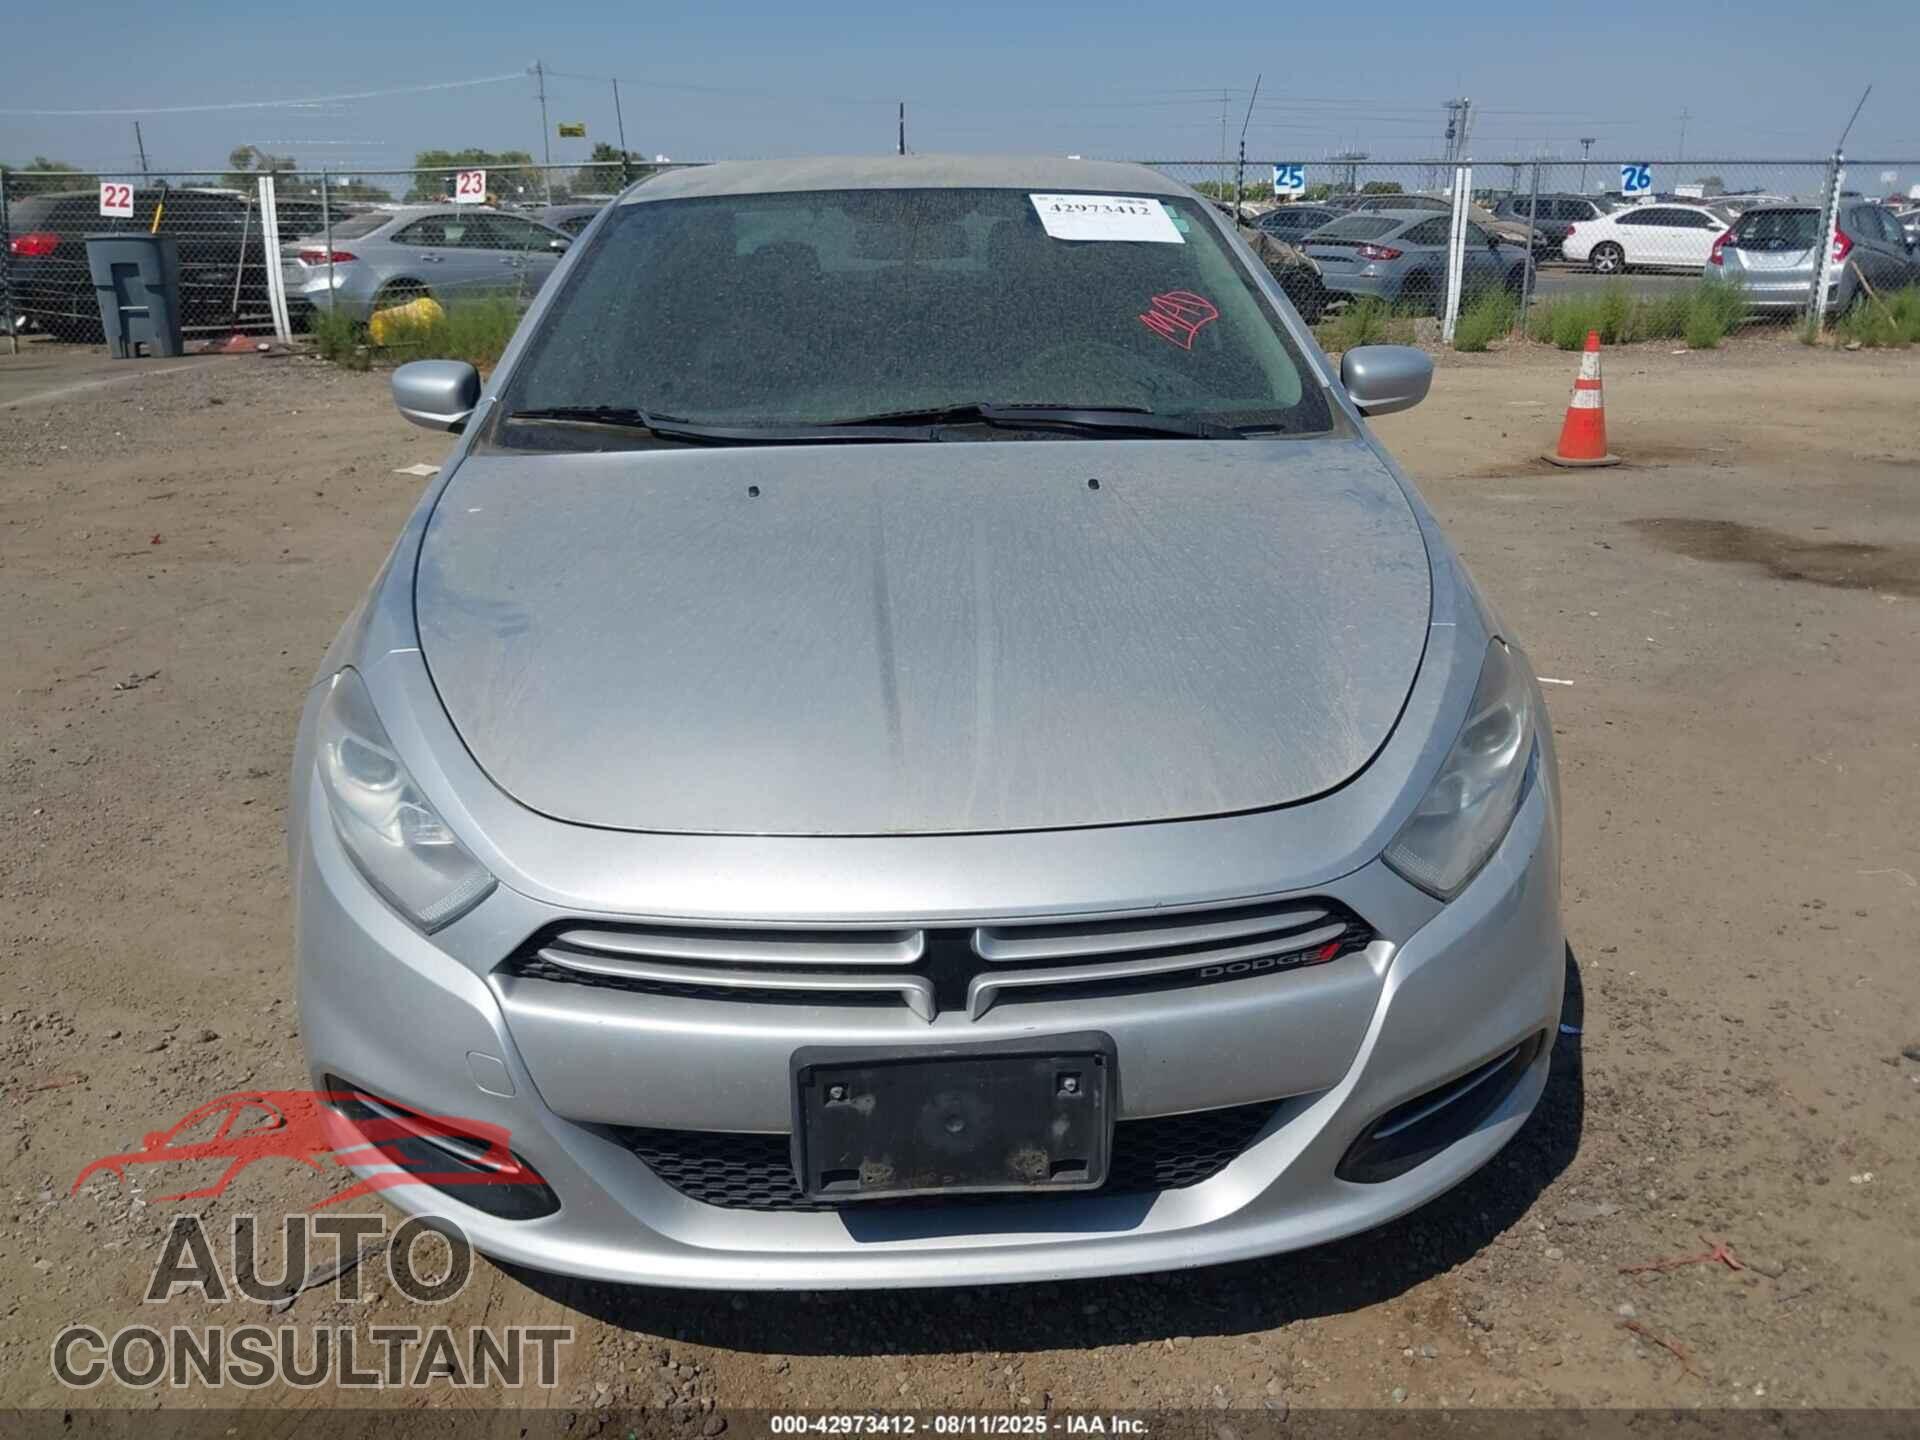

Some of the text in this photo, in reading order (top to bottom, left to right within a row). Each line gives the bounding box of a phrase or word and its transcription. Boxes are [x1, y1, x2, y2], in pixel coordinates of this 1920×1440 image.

[460, 172, 482, 194] 23
[1275, 164, 1304, 189] 25
[1621, 164, 1651, 191] 26
[104, 185, 130, 208] 22
[1050, 203, 1151, 216] 42973412
[1199, 951, 1322, 978] DODGE
